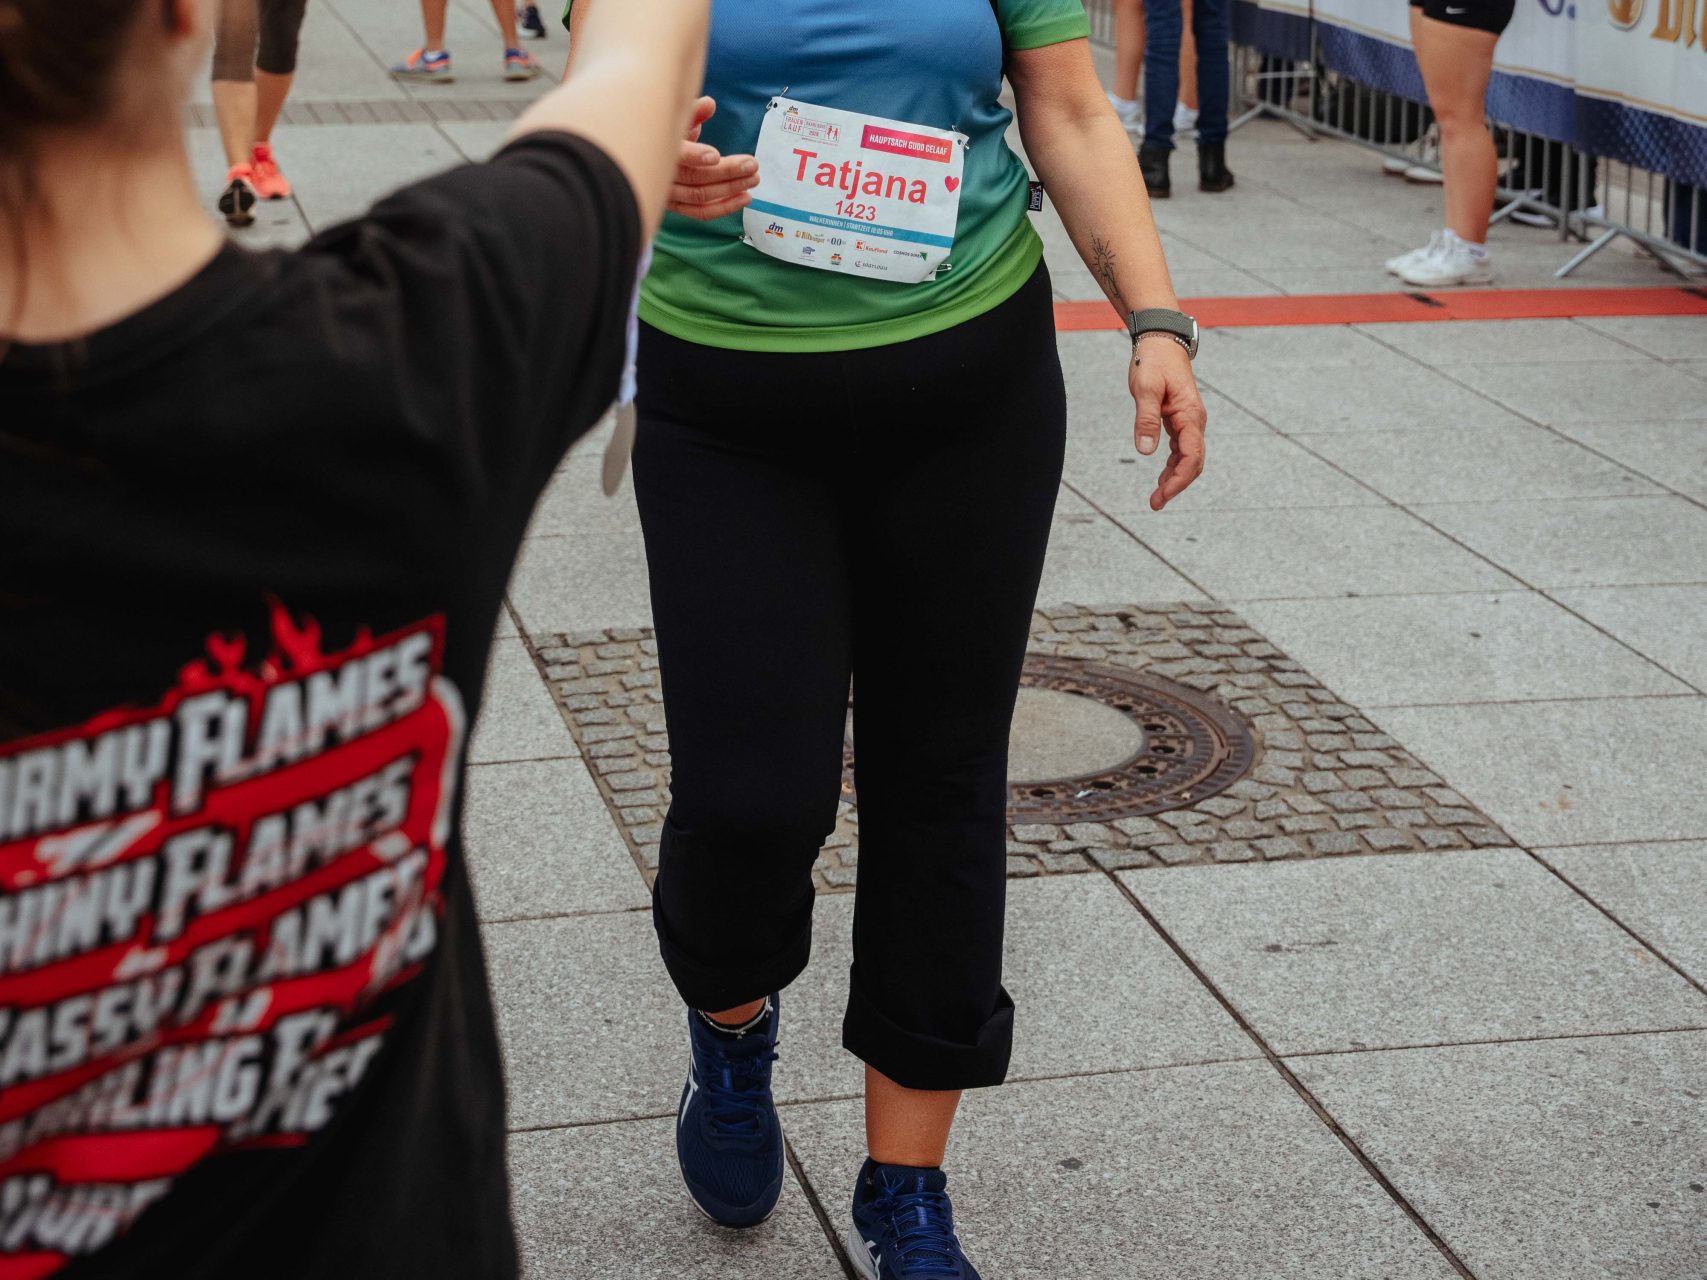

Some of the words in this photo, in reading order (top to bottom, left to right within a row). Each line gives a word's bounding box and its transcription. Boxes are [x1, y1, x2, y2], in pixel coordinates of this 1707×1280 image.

[869, 134, 907, 149] HAUPTSACH
[908, 141, 924, 152] GUDD
[925, 144, 948, 156] GELAAF
[792, 148, 928, 204] Tatjana
[768, 222, 784, 233] dm
[835, 200, 877, 222] 1423
[172, 631, 432, 814] FLAMES
[156, 753, 413, 939] FLAMES
[0, 968, 185, 1086] ASSY
